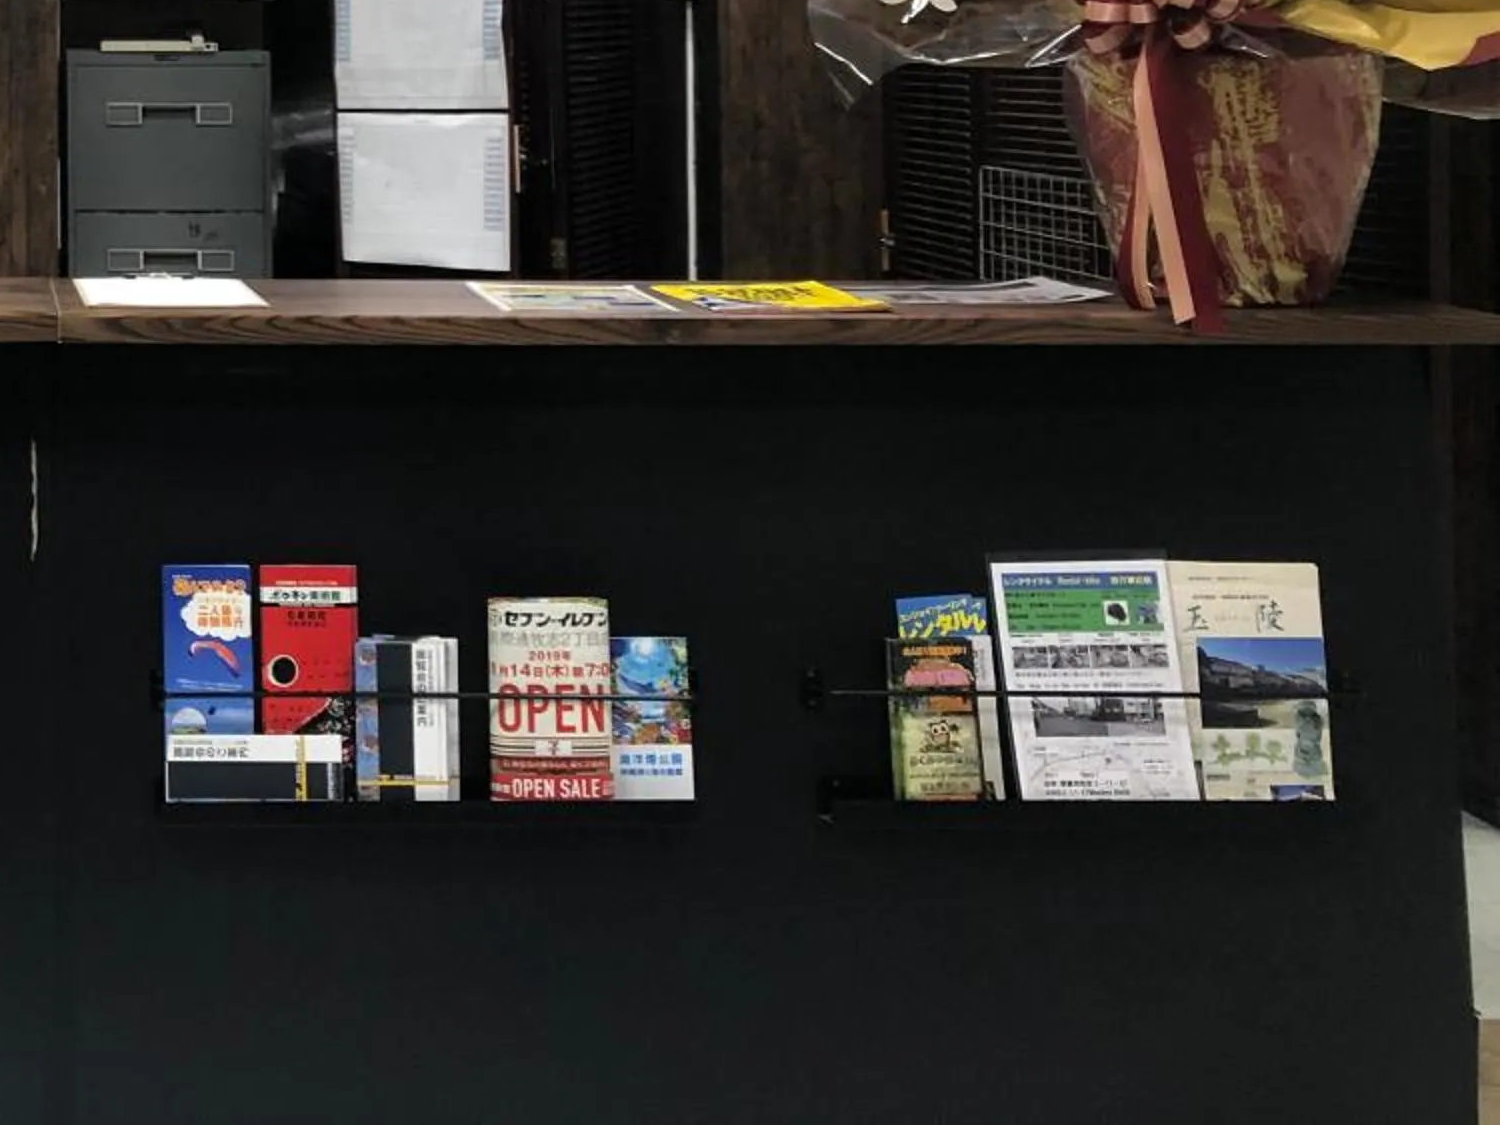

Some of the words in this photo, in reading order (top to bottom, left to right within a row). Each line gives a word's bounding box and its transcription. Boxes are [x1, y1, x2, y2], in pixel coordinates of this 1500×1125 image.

[498, 682, 605, 733] OPEN
[512, 777, 556, 799] OPEN
[559, 777, 601, 799] SALE
